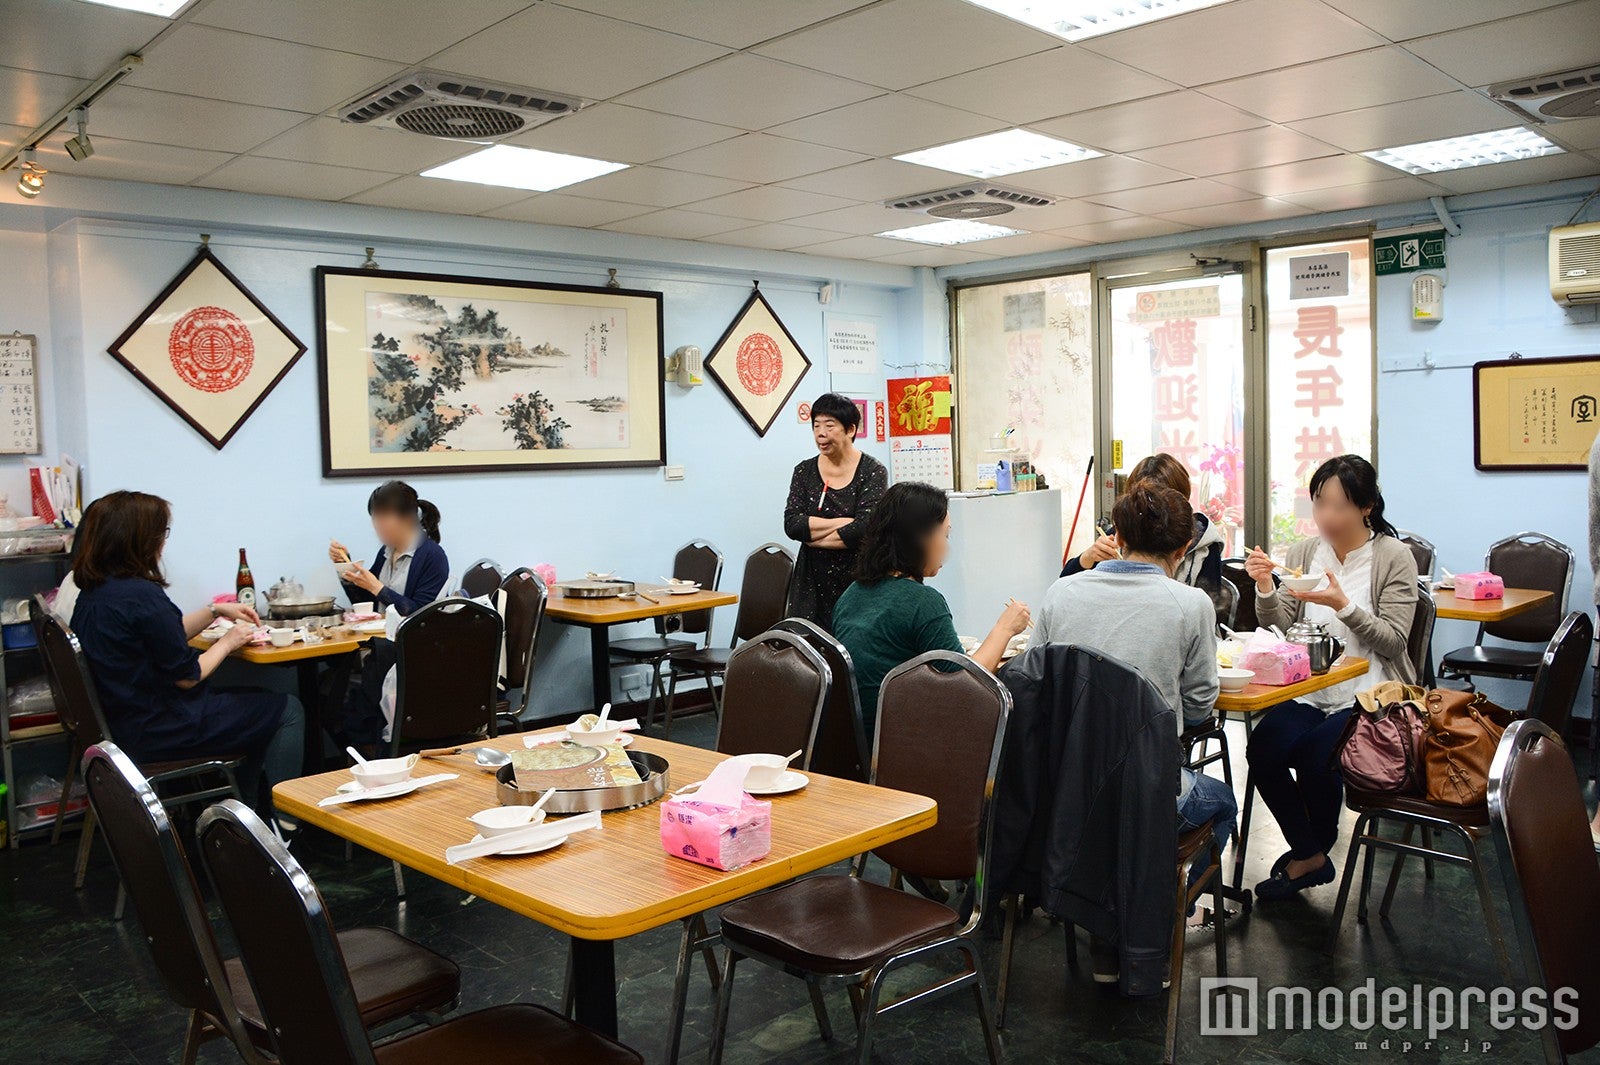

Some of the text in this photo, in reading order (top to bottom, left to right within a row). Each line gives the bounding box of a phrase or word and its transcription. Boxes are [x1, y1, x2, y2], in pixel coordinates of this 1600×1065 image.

[1425, 243, 1442, 254] 出口
[897, 381, 939, 431] 福
[917, 440, 922, 448] 3
